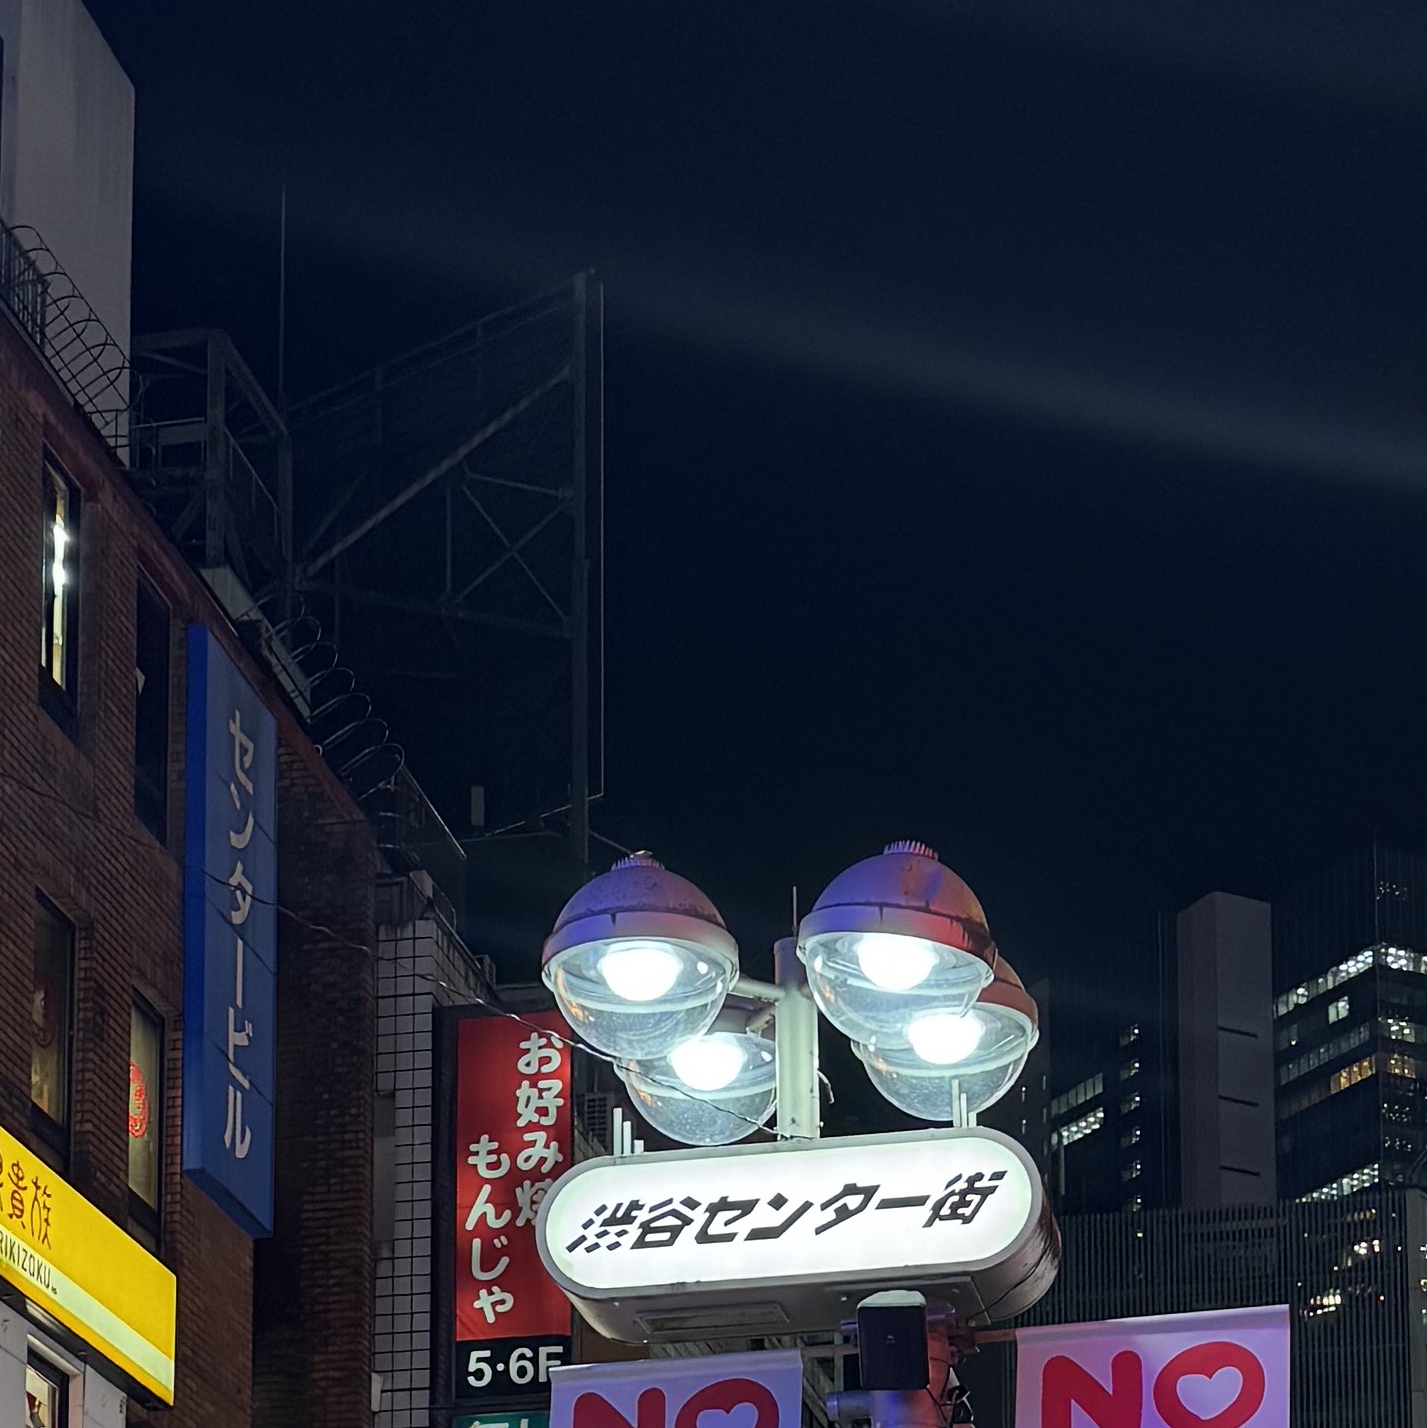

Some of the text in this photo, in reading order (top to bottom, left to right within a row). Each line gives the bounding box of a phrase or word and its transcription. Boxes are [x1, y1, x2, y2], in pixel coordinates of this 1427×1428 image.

[224, 707, 256, 1160] センタービル
[465, 1133, 515, 1324] もんじゃ
[565, 1169, 1009, 1255] 渋谷センター街
